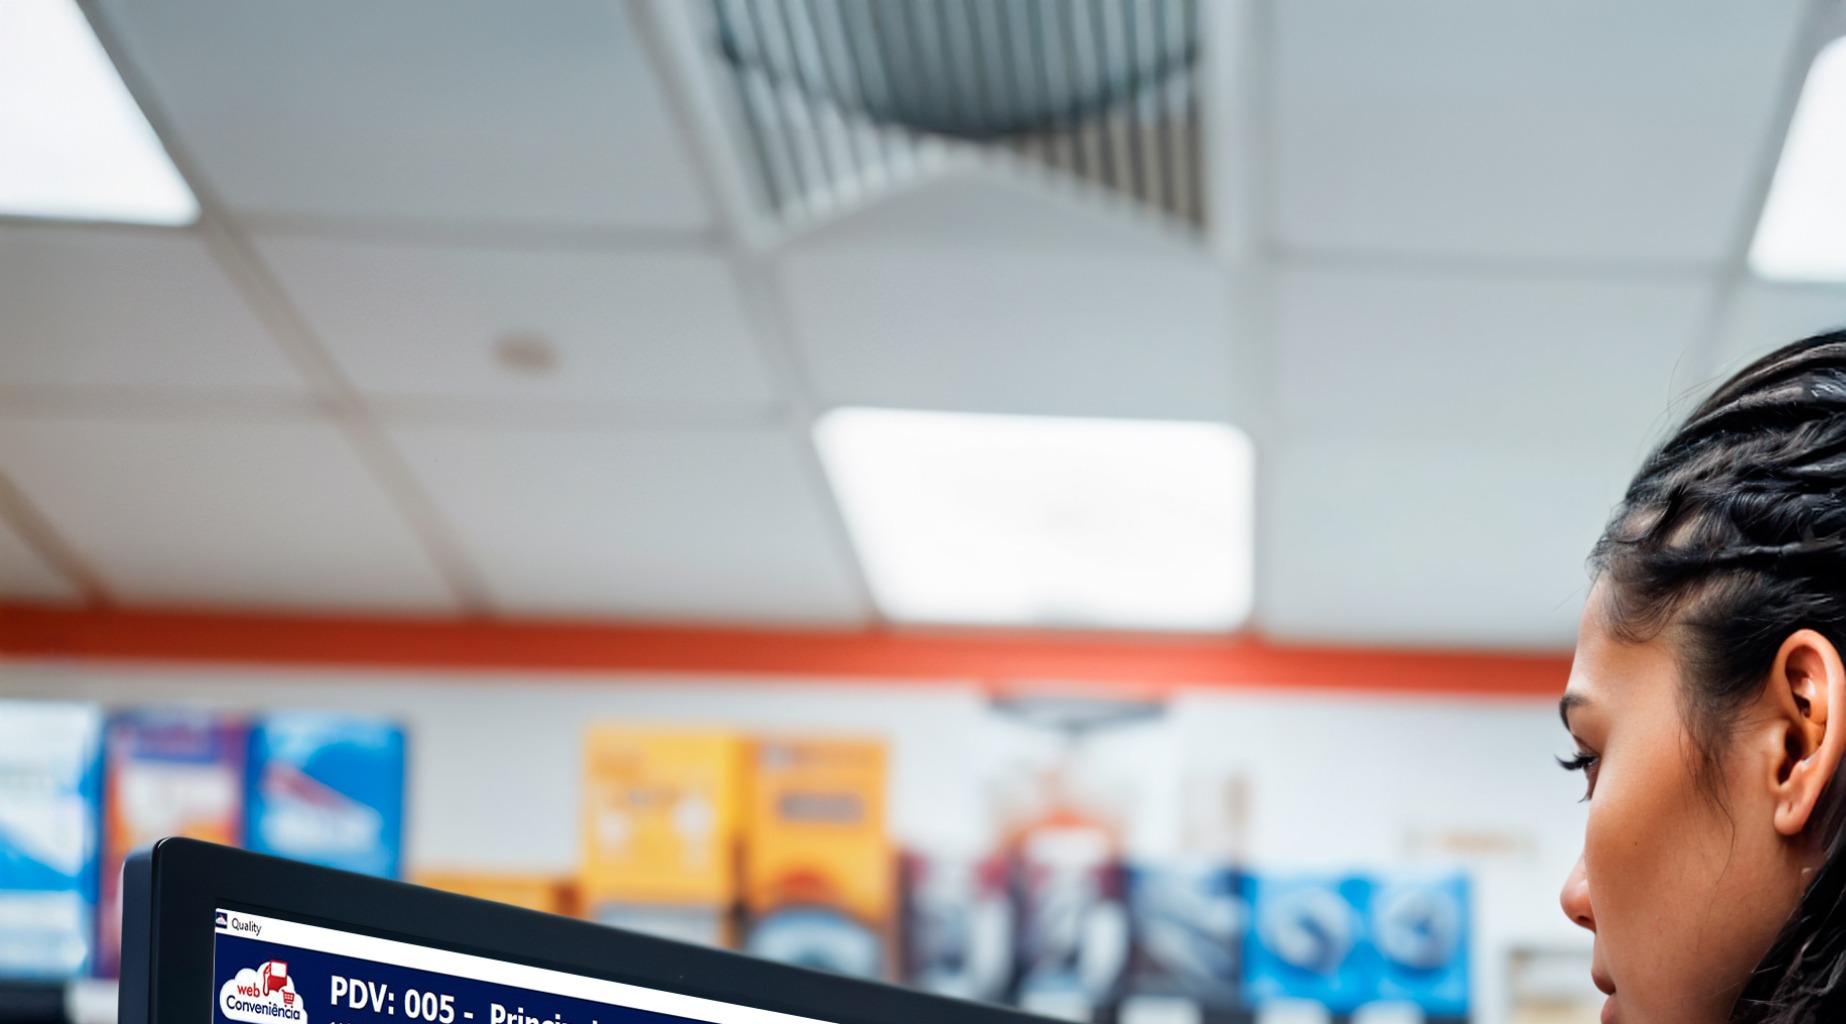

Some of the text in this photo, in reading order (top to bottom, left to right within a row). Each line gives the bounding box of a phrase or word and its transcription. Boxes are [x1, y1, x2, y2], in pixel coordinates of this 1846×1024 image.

[231, 918, 262, 936] Quality
[237, 983, 260, 997] web
[331, 975, 395, 1015] PDV:
[404, 989, 455, 1024] 005
[226, 996, 300, 1021] Conveniência
